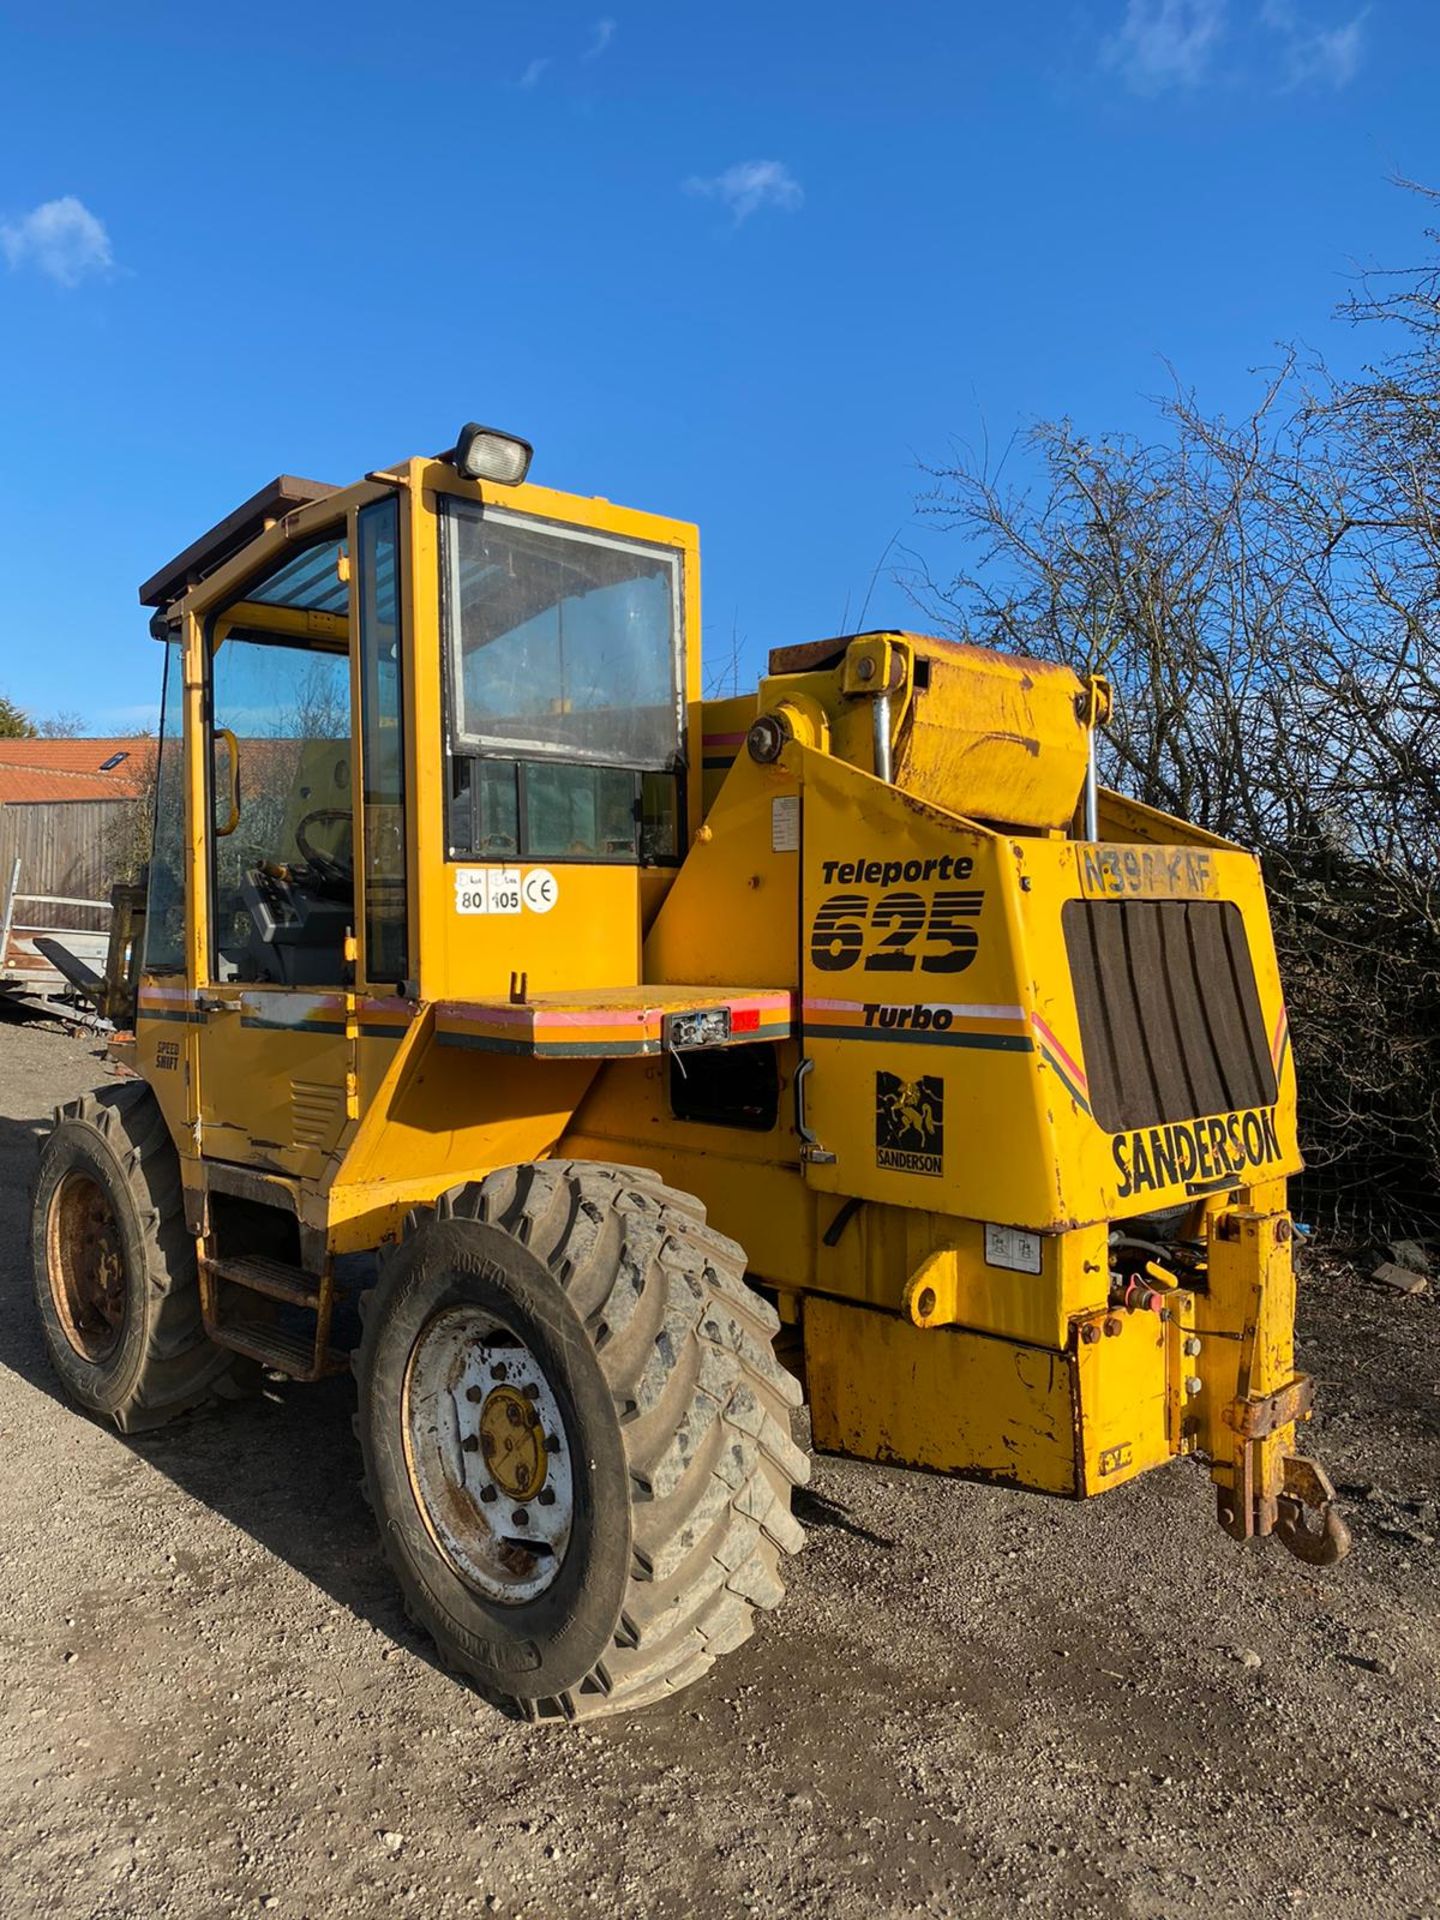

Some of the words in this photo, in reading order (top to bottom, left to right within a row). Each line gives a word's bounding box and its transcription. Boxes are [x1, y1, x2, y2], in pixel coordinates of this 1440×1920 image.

[822, 855, 974, 887] Teleporte
[462, 892, 482, 908] 80
[526, 879, 551, 903] CE
[811, 890, 985, 974] 625
[863, 1003, 953, 1030] Turbo
[156, 1041, 180, 1056] SPEED
[156, 1055, 178, 1071] SHIFT
[877, 1151, 943, 1174] SANDERSON
[1112, 1109, 1282, 1198] SANDERSON
